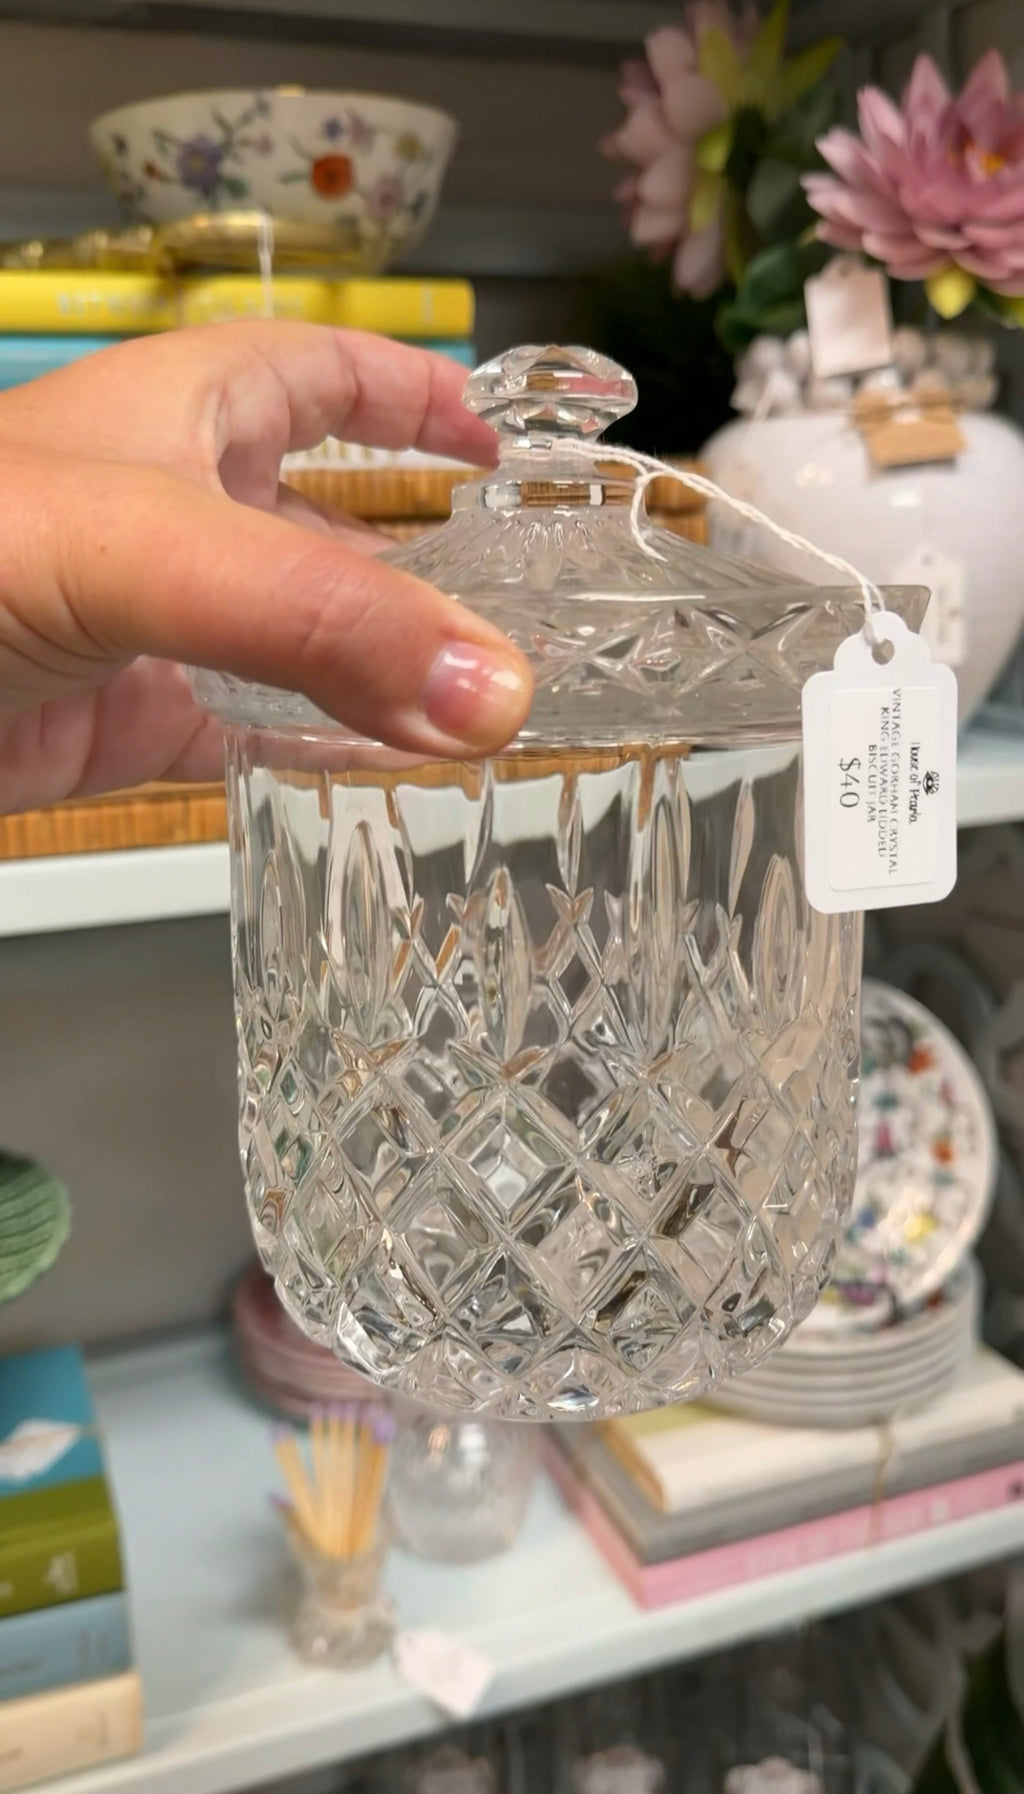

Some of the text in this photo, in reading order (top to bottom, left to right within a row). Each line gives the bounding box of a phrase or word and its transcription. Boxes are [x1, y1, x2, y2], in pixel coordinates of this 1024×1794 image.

[837, 756, 862, 809] $40
[866, 744, 878, 823] BISCUIT JAR
[877, 706, 890, 858] KING EDWARD LIDDED
[888, 688, 902, 875] VINTAGE GORHAM CRYSTAL
[909, 741, 921, 770] House
[910, 773, 921, 786] of
